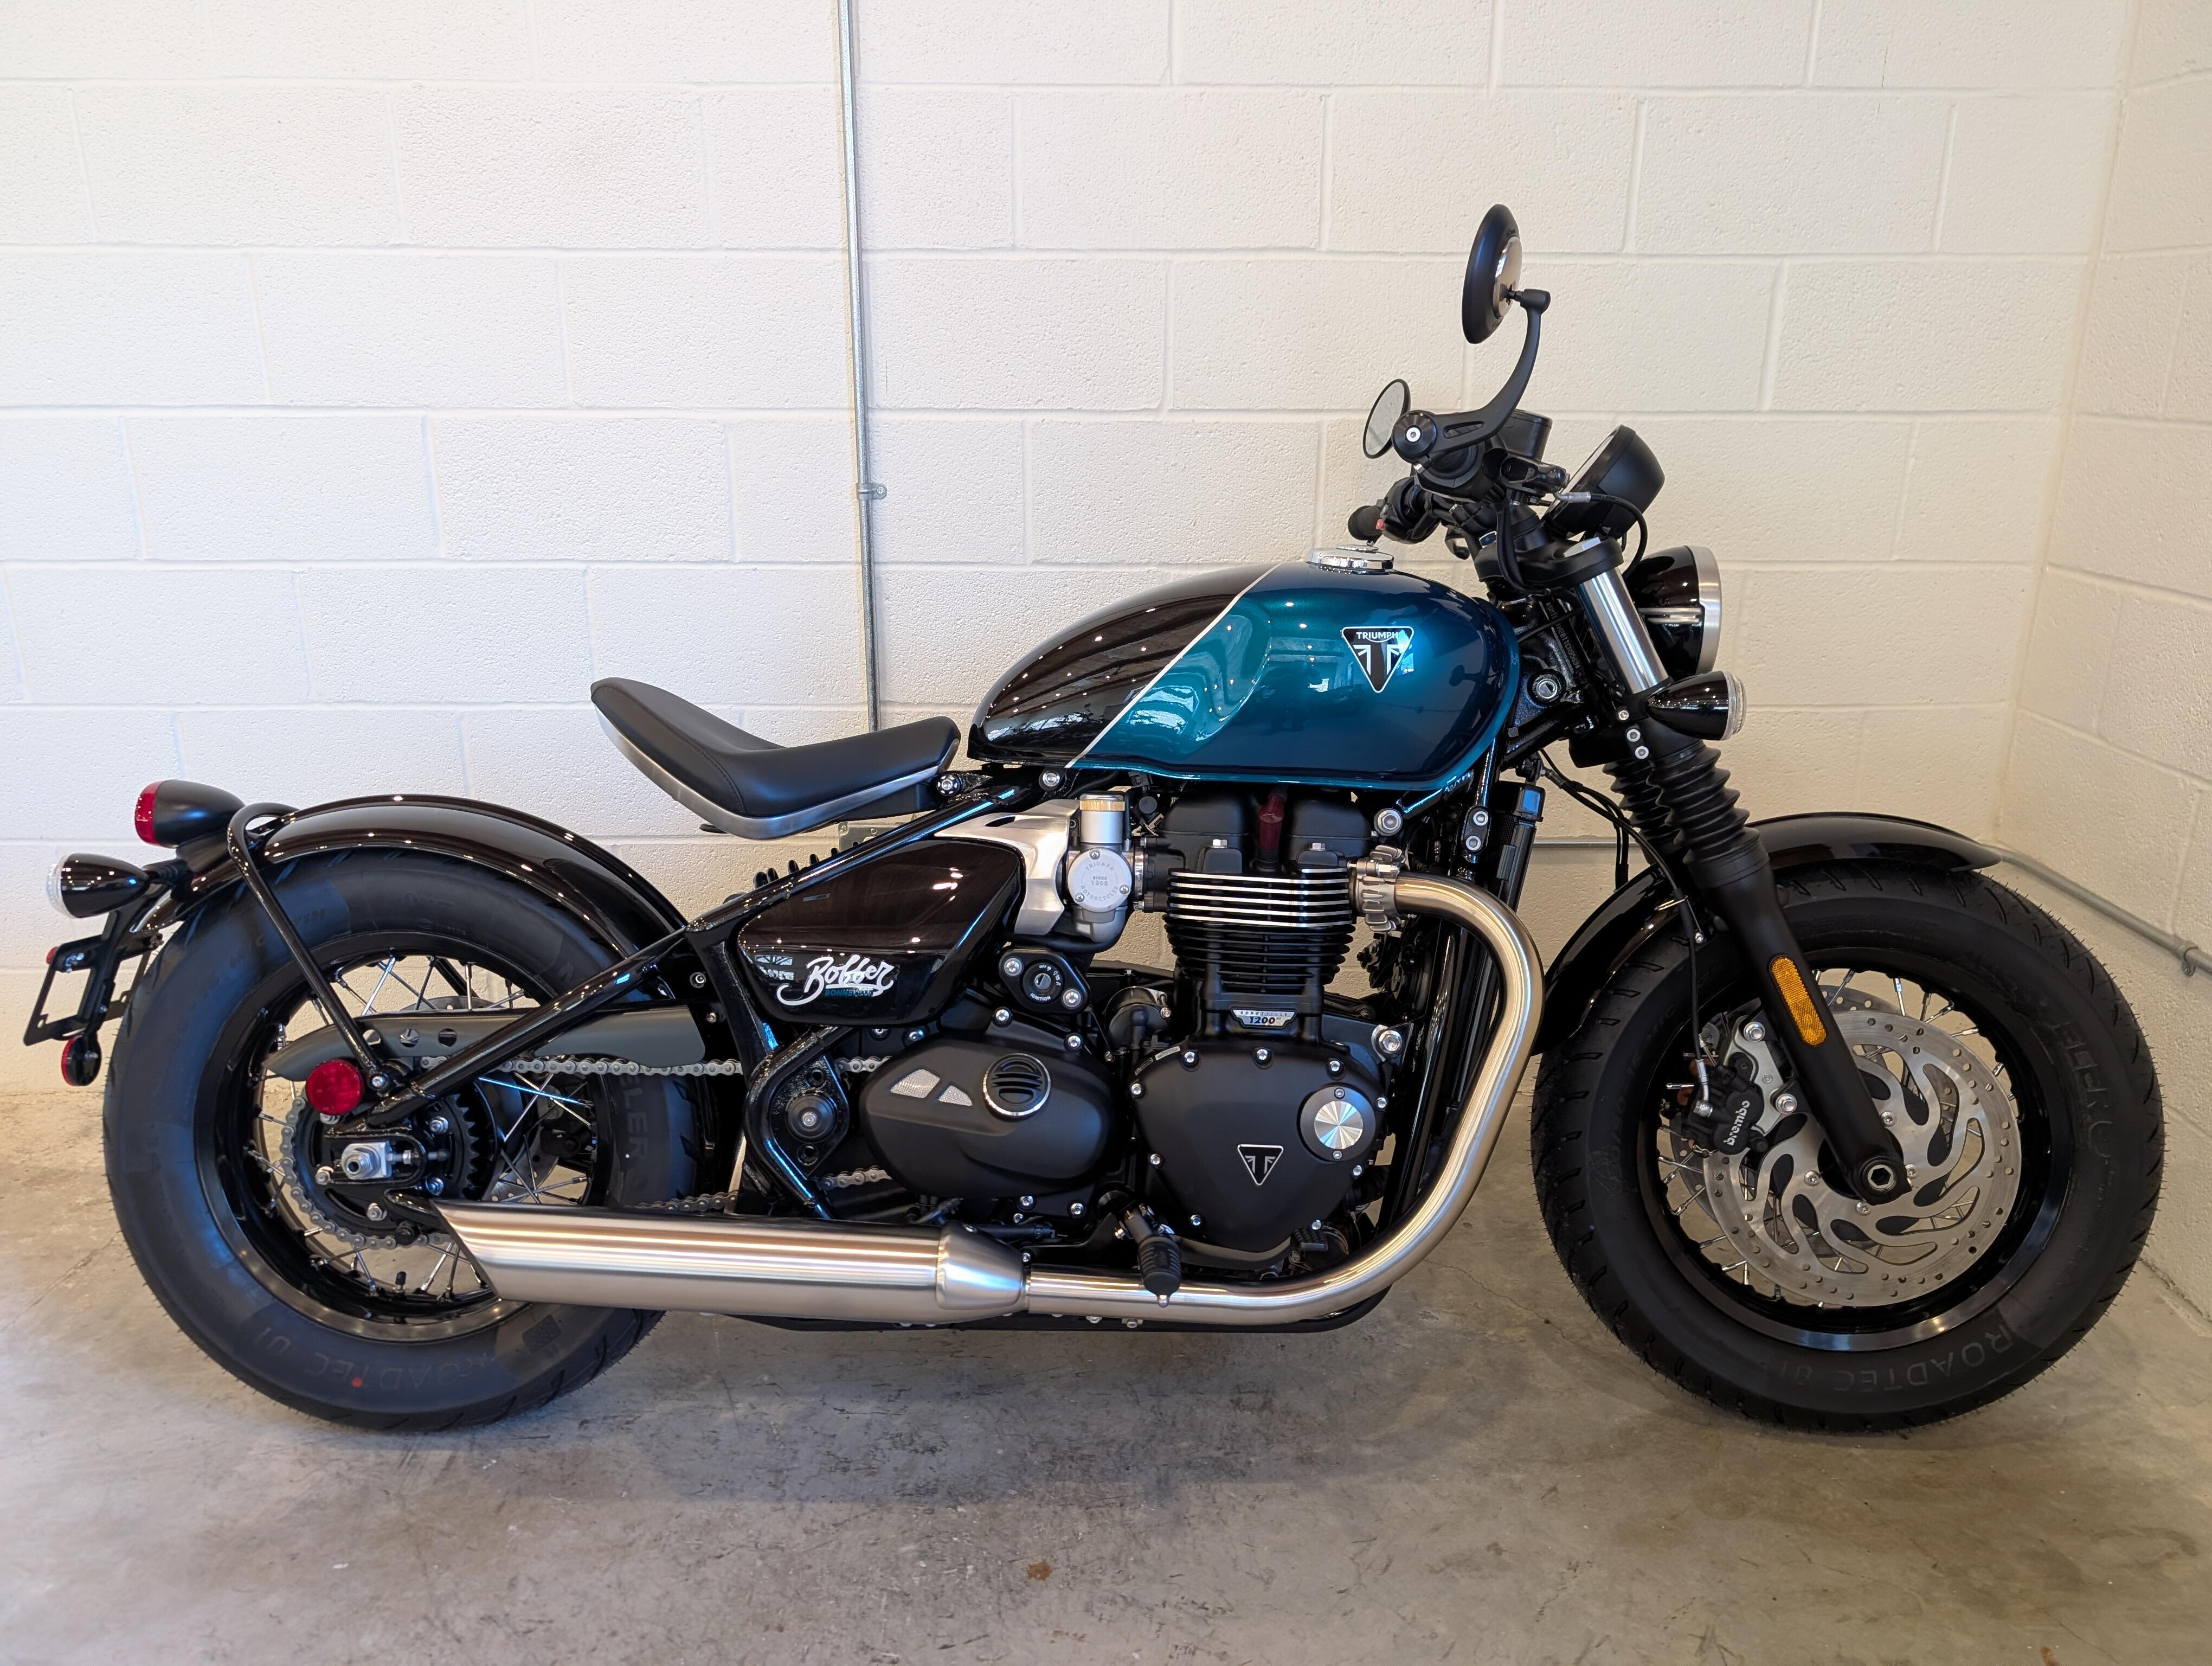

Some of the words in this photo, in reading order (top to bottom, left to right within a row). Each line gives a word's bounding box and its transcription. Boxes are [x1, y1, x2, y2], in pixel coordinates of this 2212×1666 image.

[1356, 631, 1399, 642] TRIUMPH
[1085, 861, 1115, 872] TRIUMPH
[1081, 885, 1118, 901] MOTORCYCLES
[776, 954, 895, 1005] Bobber
[1030, 992, 1051, 1001] IGNITION
[1723, 1100, 1750, 1146] brembo
[1832, 1323, 2014, 1392] ROADTEC
